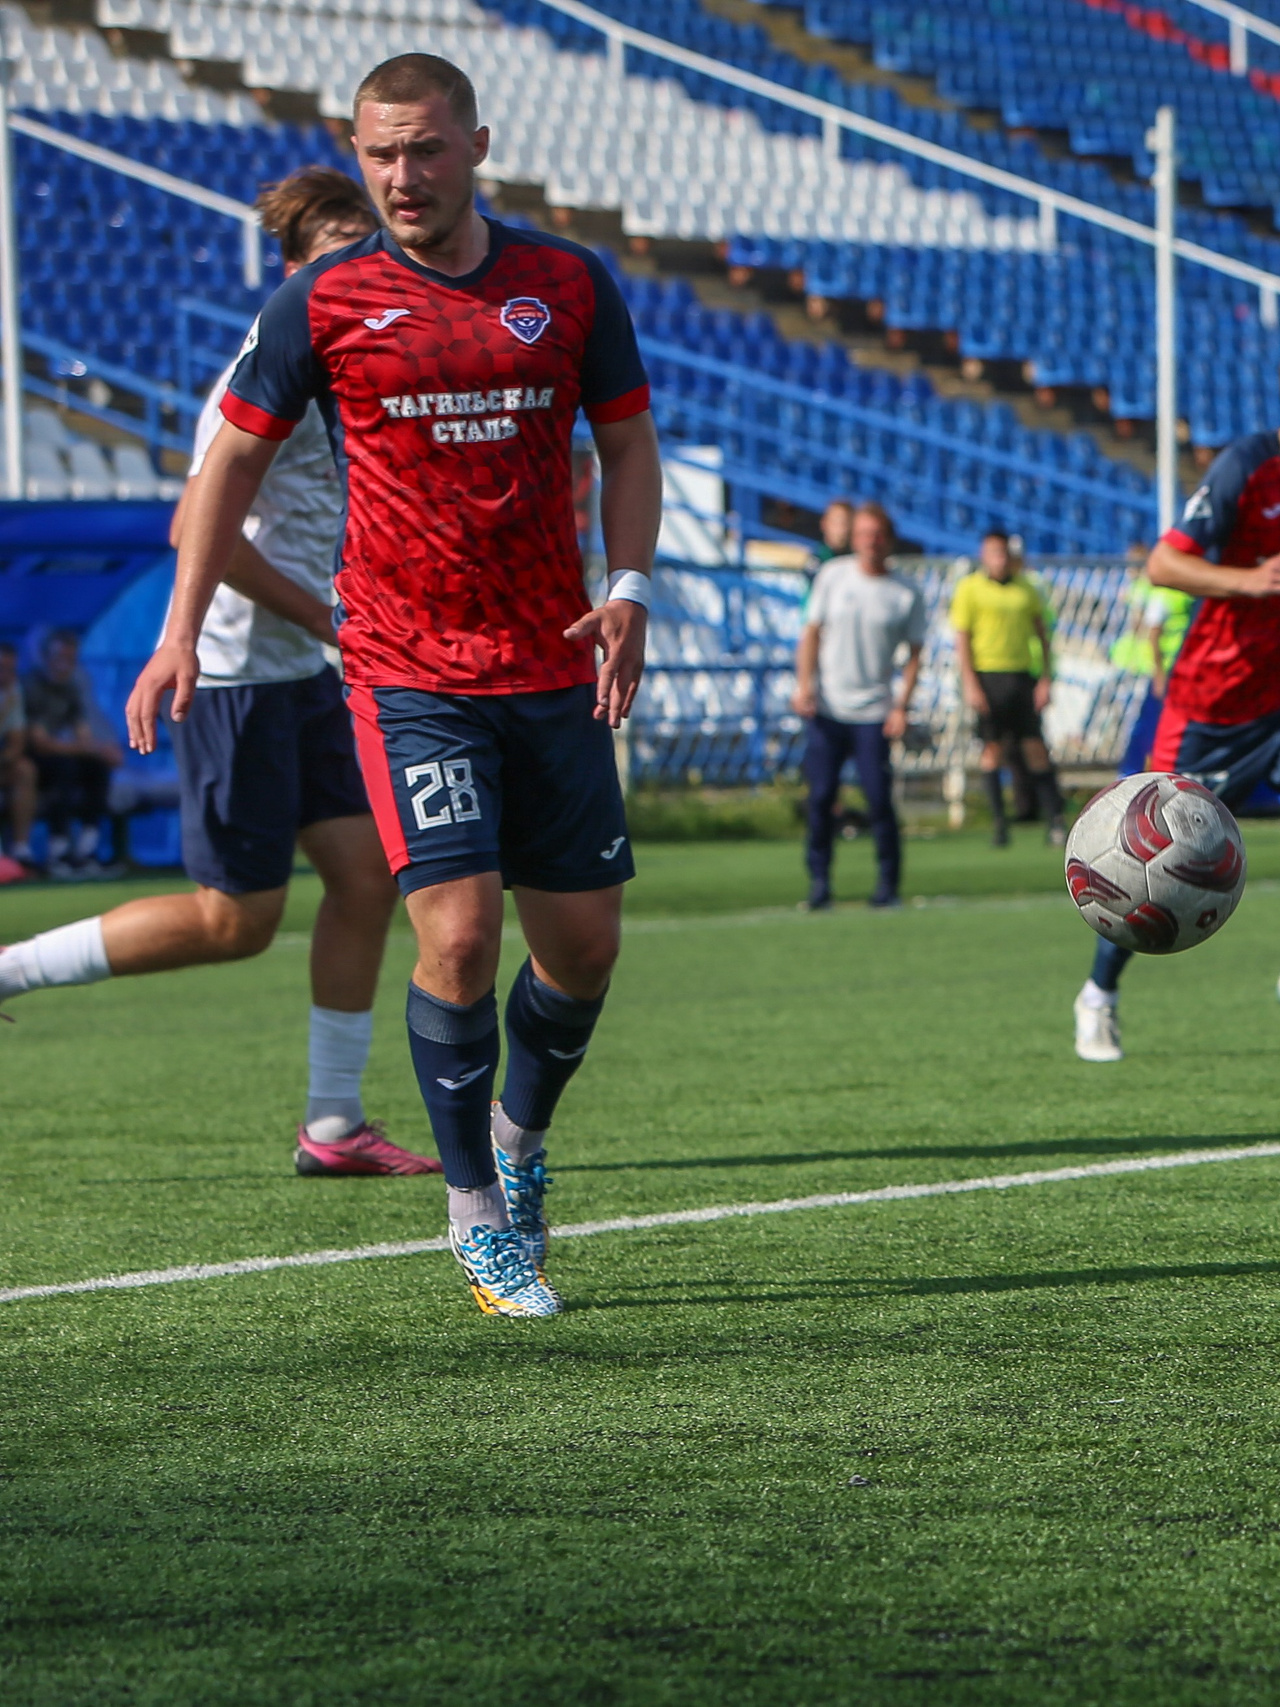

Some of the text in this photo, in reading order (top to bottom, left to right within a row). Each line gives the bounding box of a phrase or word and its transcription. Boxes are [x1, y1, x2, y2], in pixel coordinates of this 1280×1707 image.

[381, 387, 555, 418] ТАГИЛЬСКАЯ
[432, 416, 519, 443] СТАЛЬ
[404, 758, 482, 831] 28
